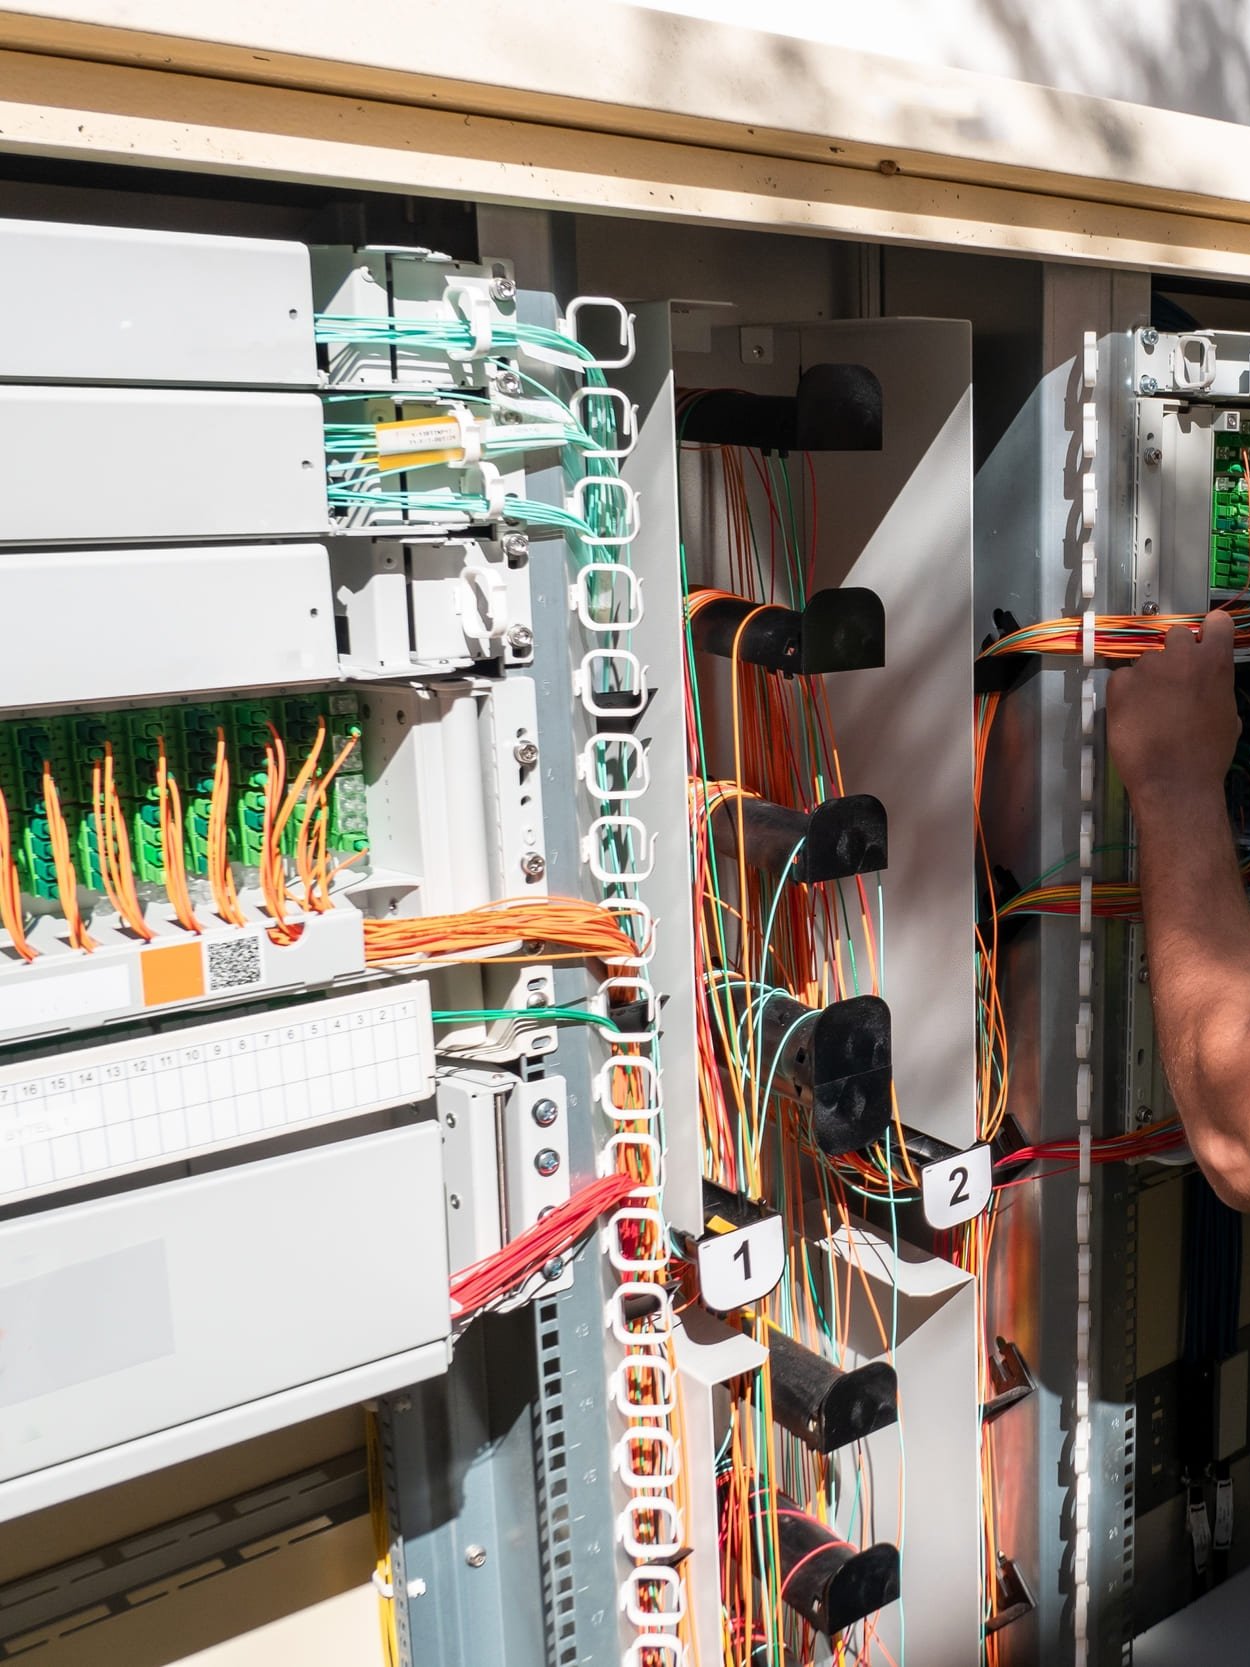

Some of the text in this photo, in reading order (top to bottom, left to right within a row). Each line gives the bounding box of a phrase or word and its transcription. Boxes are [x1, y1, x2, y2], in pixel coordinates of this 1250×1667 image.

[23, 1084, 38, 1096] 16
[51, 1078, 66, 1089] 15
[79, 1073, 93, 1084] 14
[106, 1066, 121, 1078] 13
[133, 1060, 148, 1072] 12
[160, 1056, 172, 1066] 11
[186, 1049, 200, 1060] 10
[213, 1045, 221, 1055] 9
[239, 1040, 246, 1050] 8
[264, 1034, 270, 1044] 7
[287, 1029, 295, 1039] 6
[311, 1025, 318, 1034] 5
[334, 1020, 341, 1029] 4
[357, 1015, 364, 1025] 3
[380, 1010, 387, 1020] 2
[949, 1166, 970, 1207] 2
[733, 1239, 752, 1281] 1
